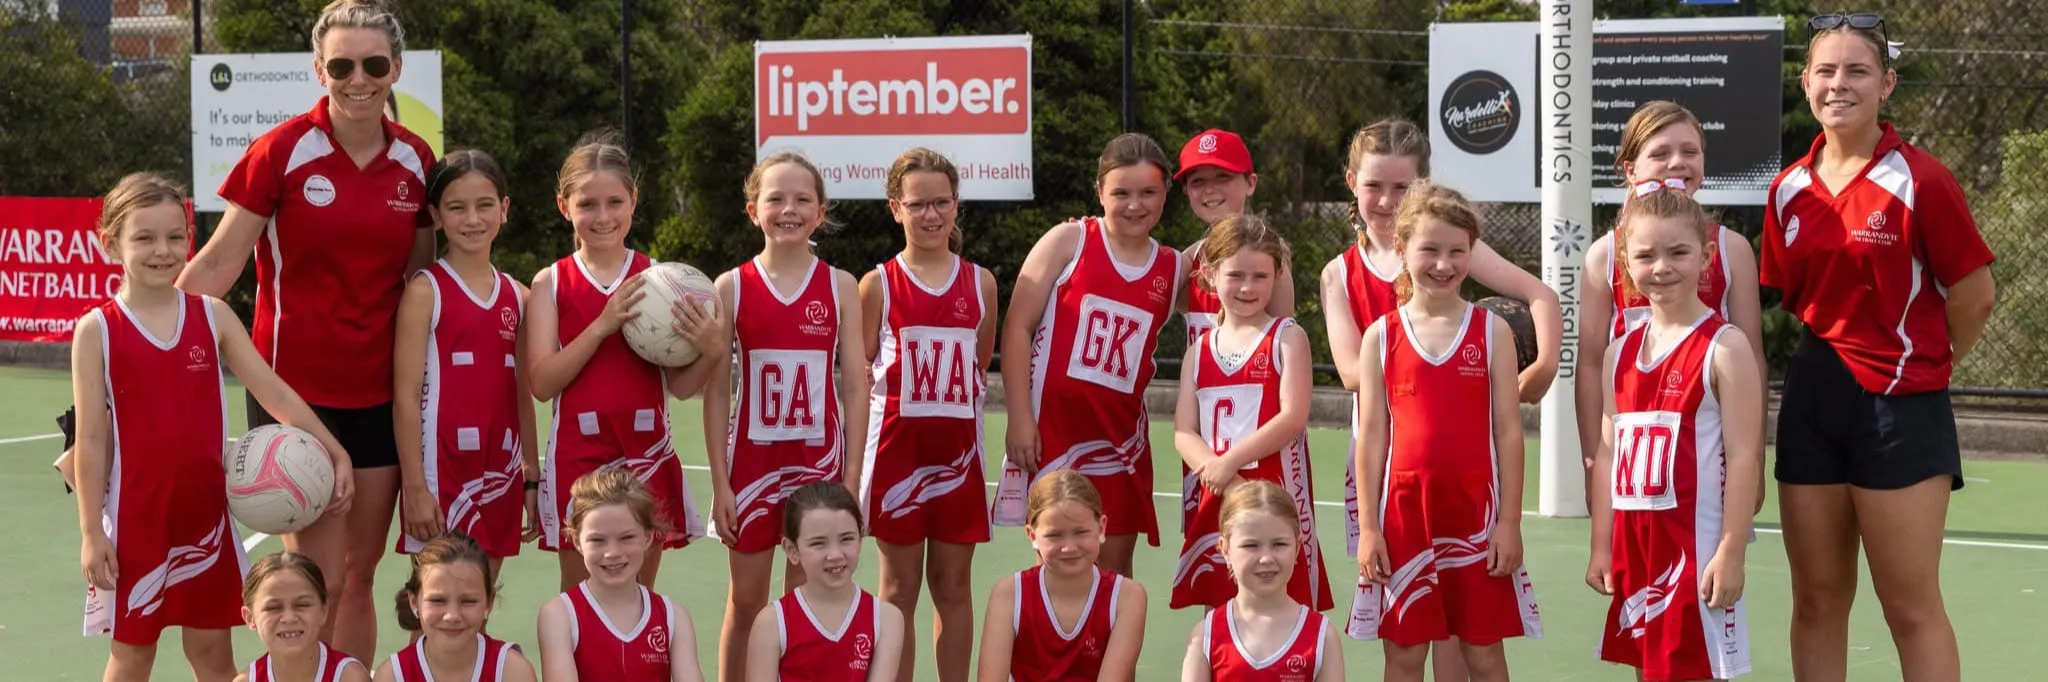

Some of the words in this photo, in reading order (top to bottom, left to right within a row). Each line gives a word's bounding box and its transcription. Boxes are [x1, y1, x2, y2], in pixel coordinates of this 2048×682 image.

[1592, 56, 1615, 66] group
[1616, 55, 1632, 64] and
[1633, 54, 1660, 65] private
[1662, 53, 1690, 63] netball
[1691, 53, 1728, 65] coaching
[235, 71, 309, 83] ORTHODONTICS
[1626, 77, 1641, 86] and
[1642, 76, 1692, 88] conditioning
[1693, 76, 1725, 88] training
[768, 62, 1019, 131] liptember.
[1552, 0, 1572, 183] RTHODONTICS
[1610, 99, 1636, 109] clinics
[209, 108, 229, 124] It's
[231, 114, 253, 125] our
[256, 110, 296, 124] busin
[1702, 121, 1725, 130] clubs
[210, 133, 223, 147] to
[226, 132, 255, 147] mak
[1592, 144, 1614, 154] ching
[819, 165, 842, 182] ing
[846, 164, 888, 180] Wom
[960, 163, 973, 179] al
[979, 162, 1031, 180] Health
[0, 228, 121, 264] ARRAN
[0, 271, 102, 299] NETBALL
[1559, 266, 1580, 378] invisalign
[1080, 307, 1142, 380] GK
[906, 339, 970, 405] WA
[759, 362, 815, 428] GA
[1213, 397, 1236, 456] C
[1616, 424, 1674, 498] WD
